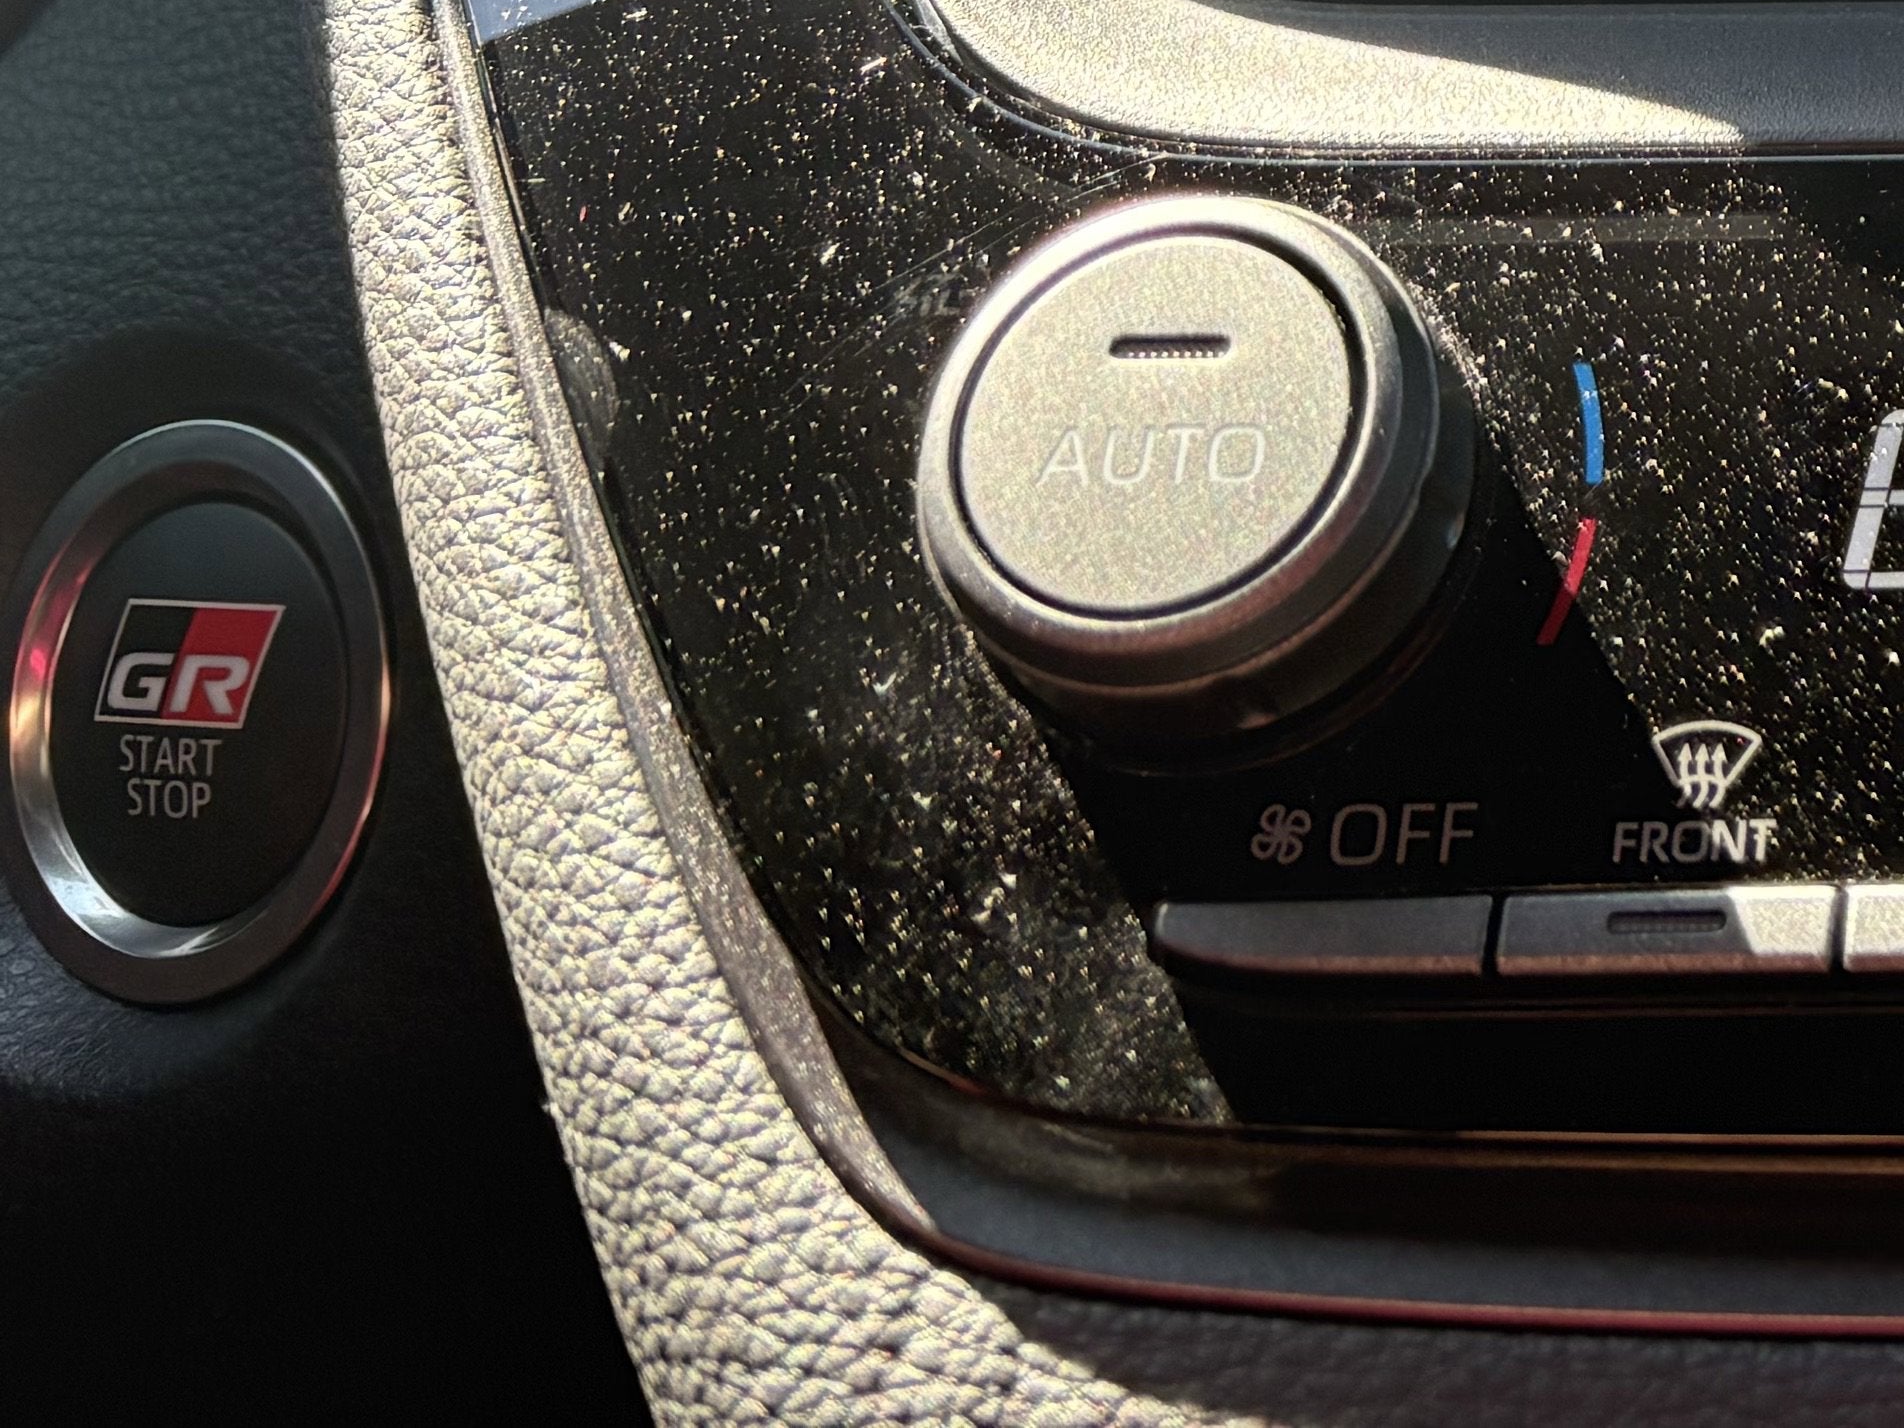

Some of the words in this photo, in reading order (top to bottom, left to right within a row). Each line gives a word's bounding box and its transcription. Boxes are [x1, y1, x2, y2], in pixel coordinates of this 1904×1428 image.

[1038, 423, 1267, 487] AUTO
[106, 652, 249, 715] GR
[119, 734, 222, 776] START
[127, 778, 212, 819] STOP
[1330, 802, 1478, 867] OFF
[1613, 817, 1778, 864] FRONT
